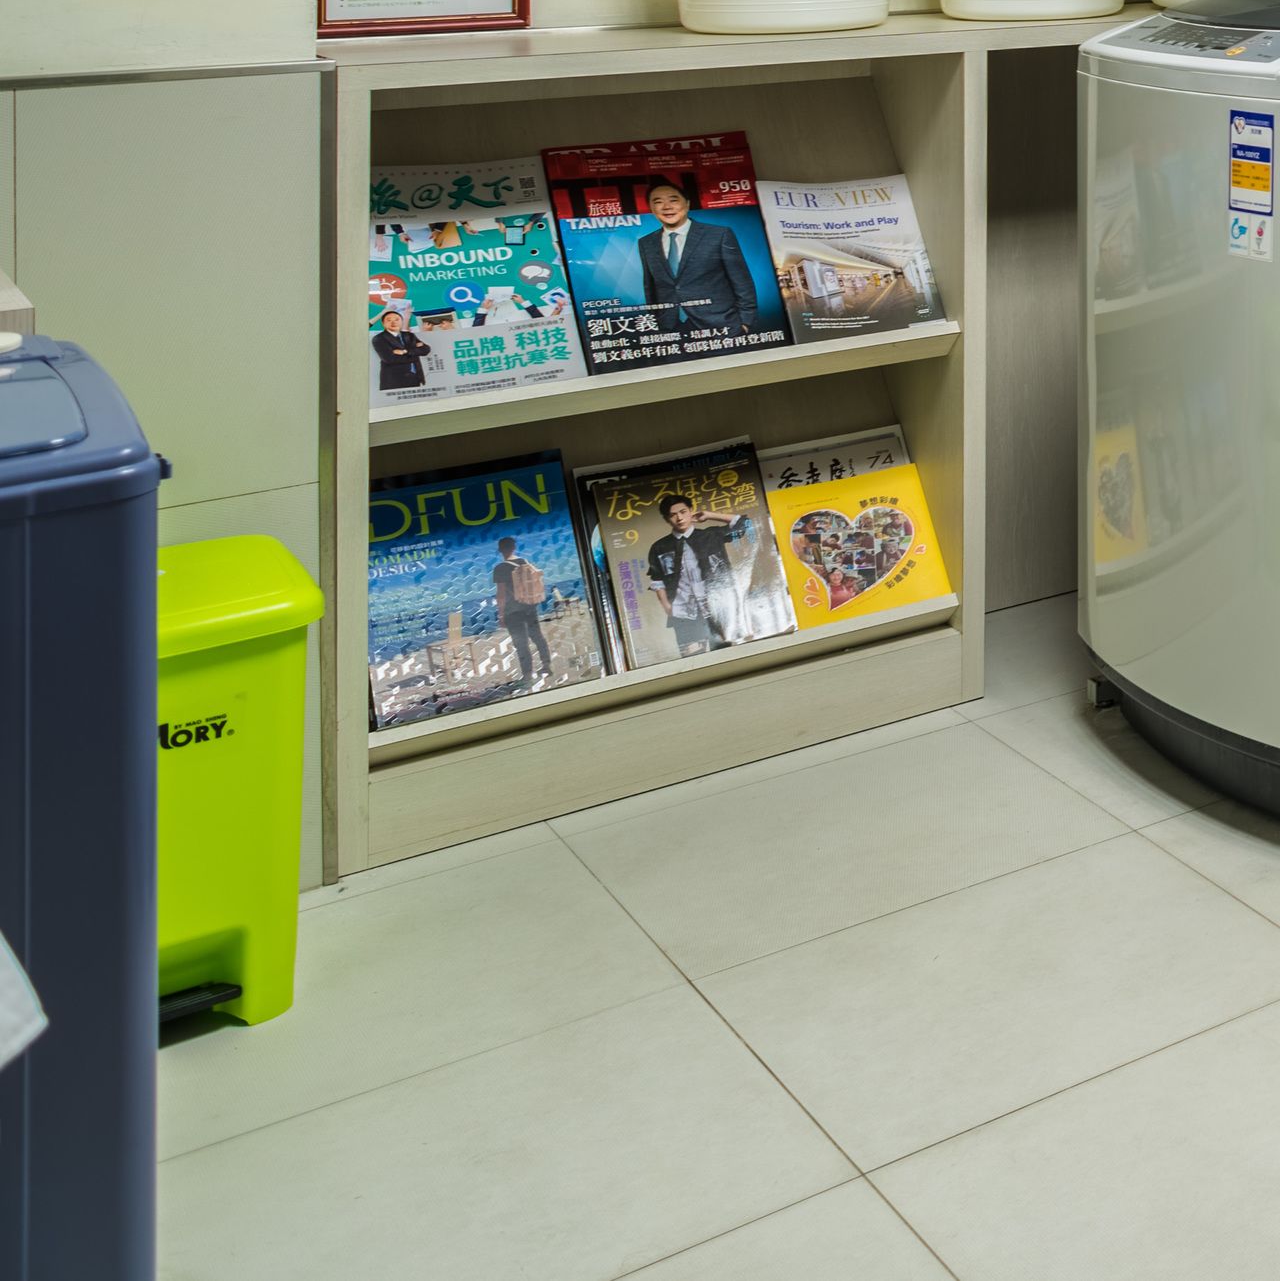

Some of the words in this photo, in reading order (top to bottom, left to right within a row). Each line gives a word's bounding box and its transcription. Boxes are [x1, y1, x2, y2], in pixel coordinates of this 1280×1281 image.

[588, 202, 623, 217] 旅報
[566, 214, 642, 231] TAIWAN
[779, 220, 821, 230] Tourism:
[823, 221, 852, 230] Work
[854, 218, 876, 228] and
[877, 216, 899, 226] Play
[399, 246, 513, 269] INBOUND
[409, 264, 507, 283] MARKETING
[582, 298, 621, 308] PEOPLE
[587, 313, 660, 338] 劉文義
[453, 335, 506, 359] 品牌
[515, 326, 568, 350] 科技
[456, 346, 572, 376] 轉型抗寒冬
[625, 529, 640, 545] 9
[368, 561, 427, 579] DESIGN
[205, 713, 227, 722] SHENG
